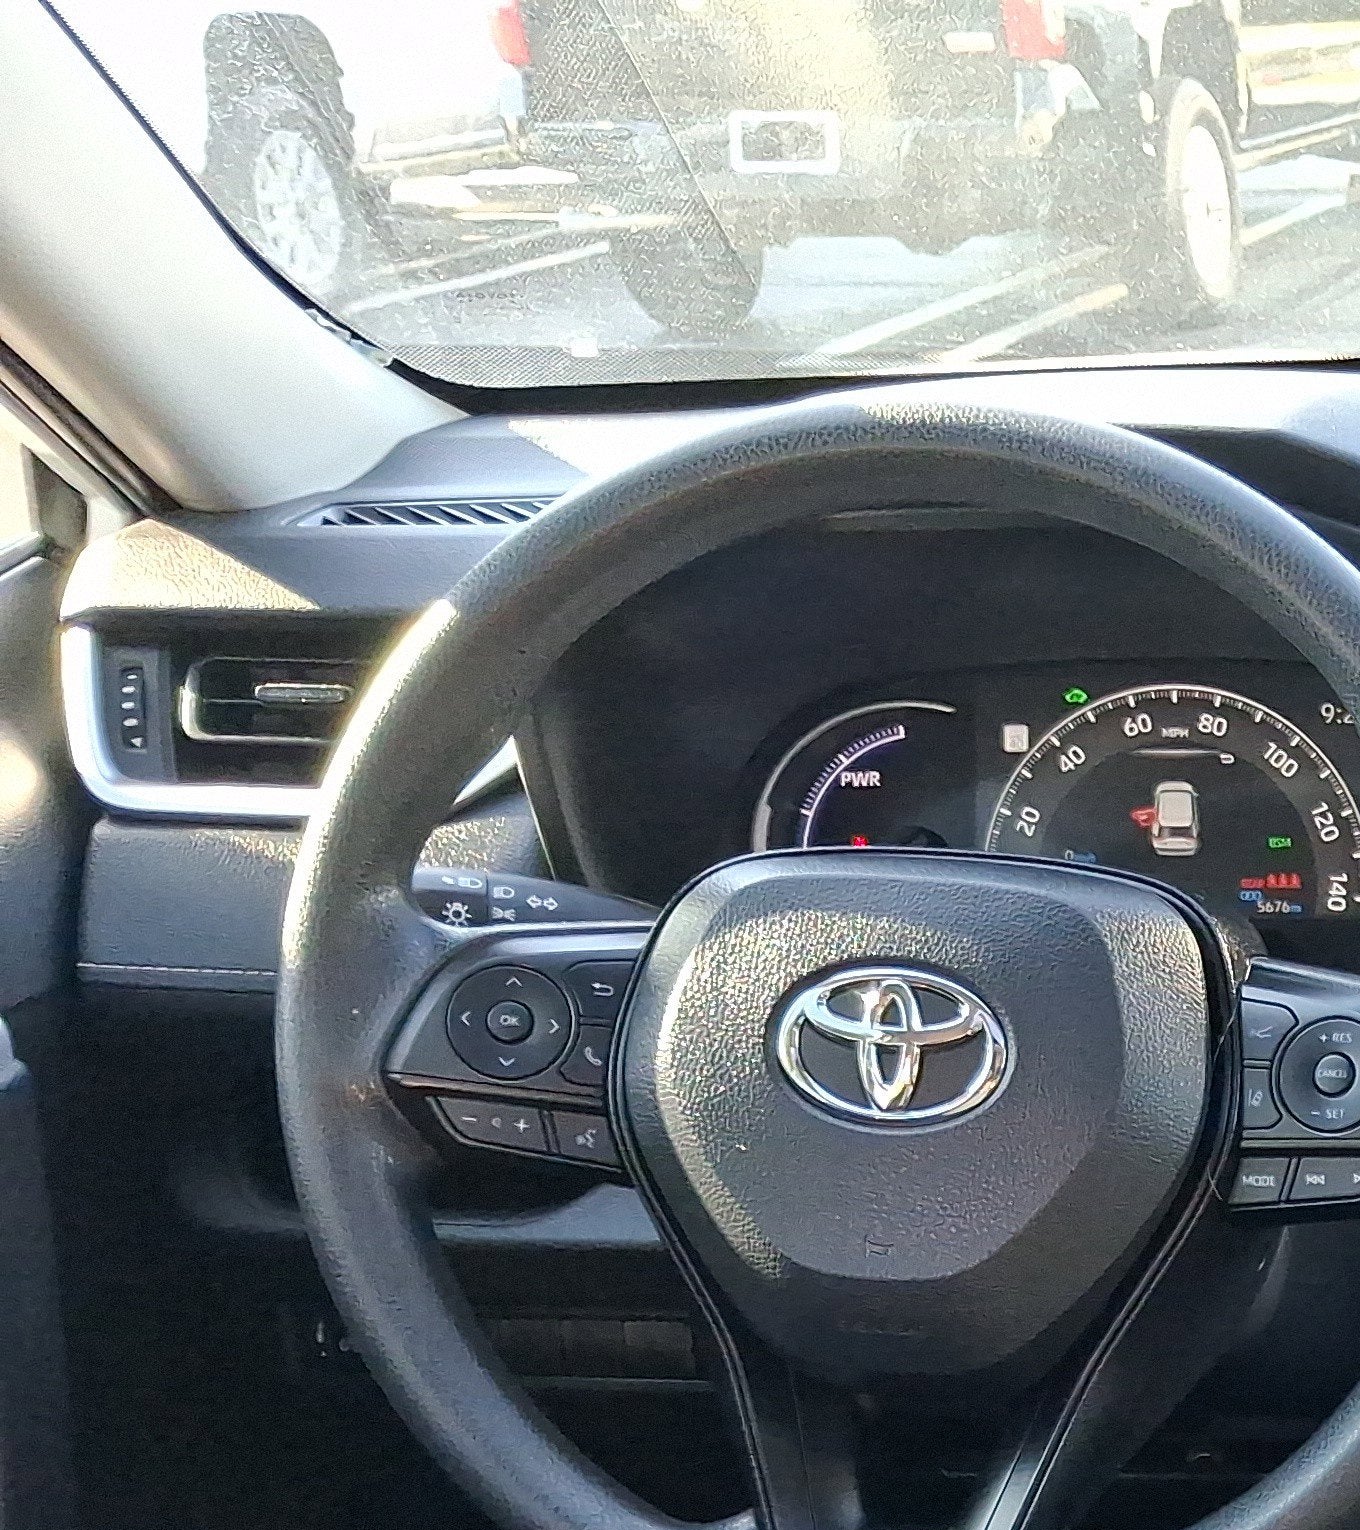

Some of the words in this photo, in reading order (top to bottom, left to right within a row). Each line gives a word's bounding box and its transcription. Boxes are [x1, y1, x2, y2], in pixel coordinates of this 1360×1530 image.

[1123, 713, 1152, 738] 60
[1198, 713, 1228, 737] 80
[1059, 744, 1086, 774] 40
[1262, 742, 1299, 778] 100
[840, 770, 882, 788] PWR
[1015, 805, 1041, 838] 20
[1310, 801, 1340, 843] 120
[1326, 872, 1349, 912] 140
[499, 1014, 520, 1027] OK
[1325, 1108, 1344, 1119] SET
